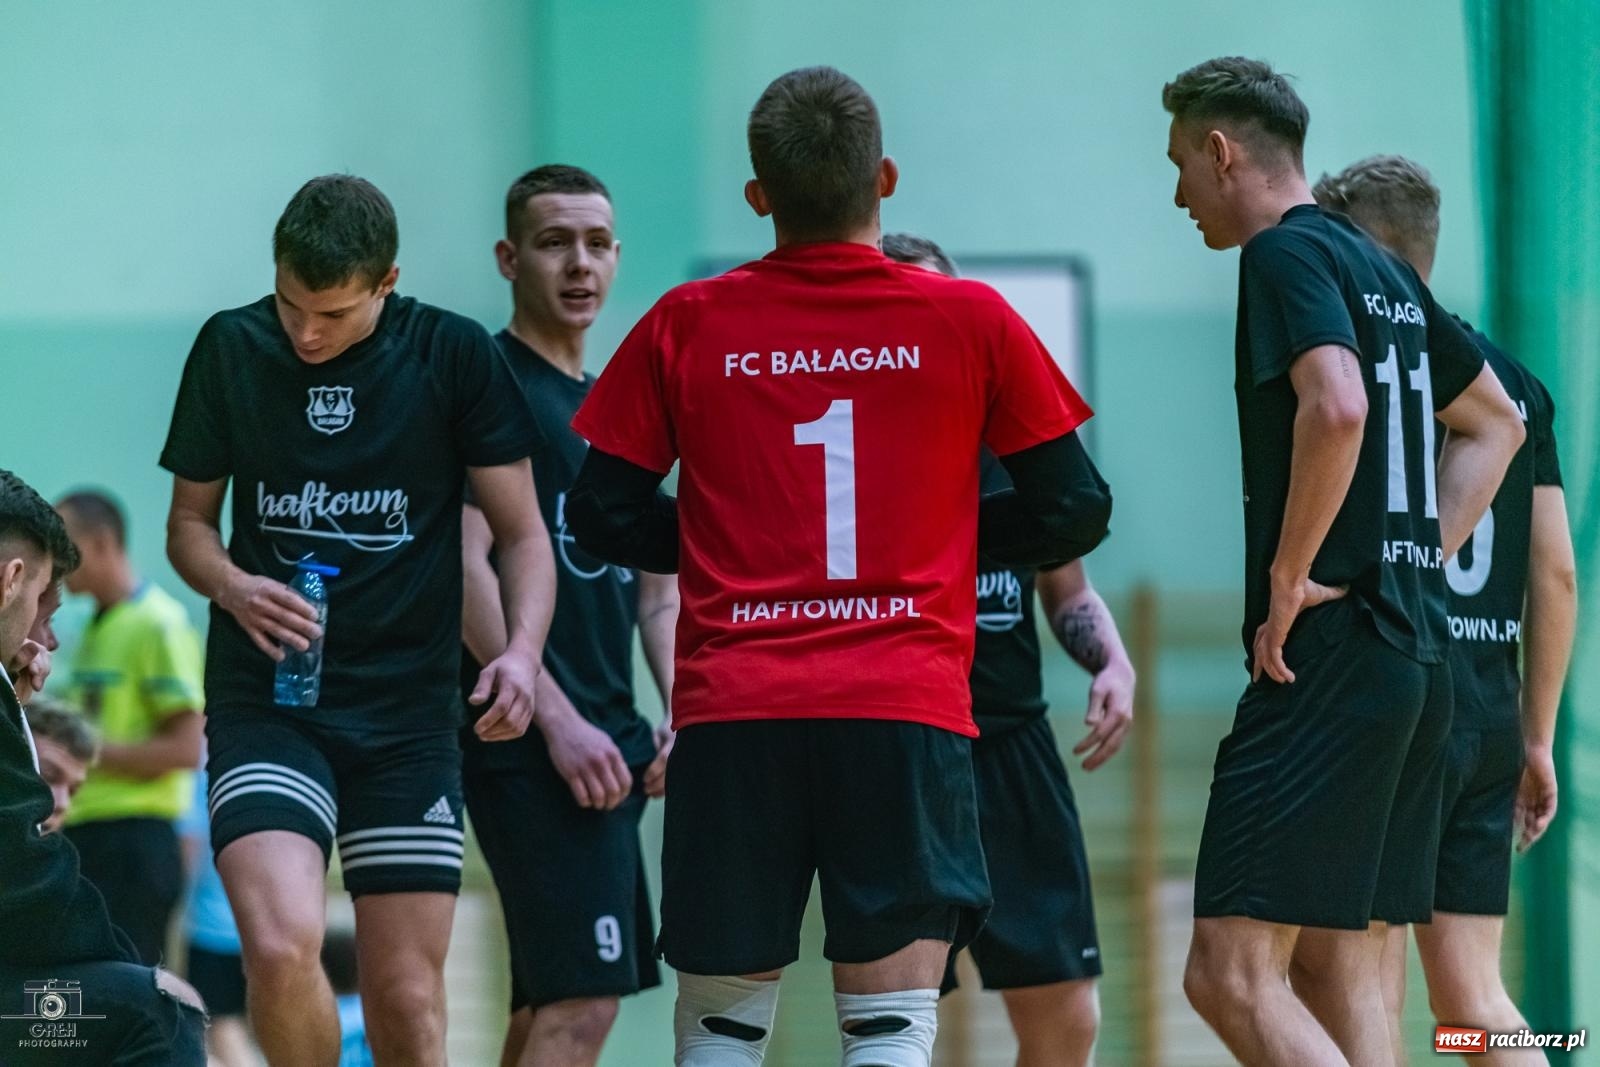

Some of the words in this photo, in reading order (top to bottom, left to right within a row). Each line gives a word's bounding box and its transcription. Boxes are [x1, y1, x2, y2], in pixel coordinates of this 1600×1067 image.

[1363, 293, 1385, 316] FC
[725, 353, 761, 377] FC
[771, 346, 920, 375] BAŁAGAN
[1375, 344, 1438, 519] 11
[257, 481, 411, 541] haftown
[793, 399, 857, 580] 1
[732, 597, 921, 624] HAFTOWN.PL
[594, 915, 622, 962] 9
